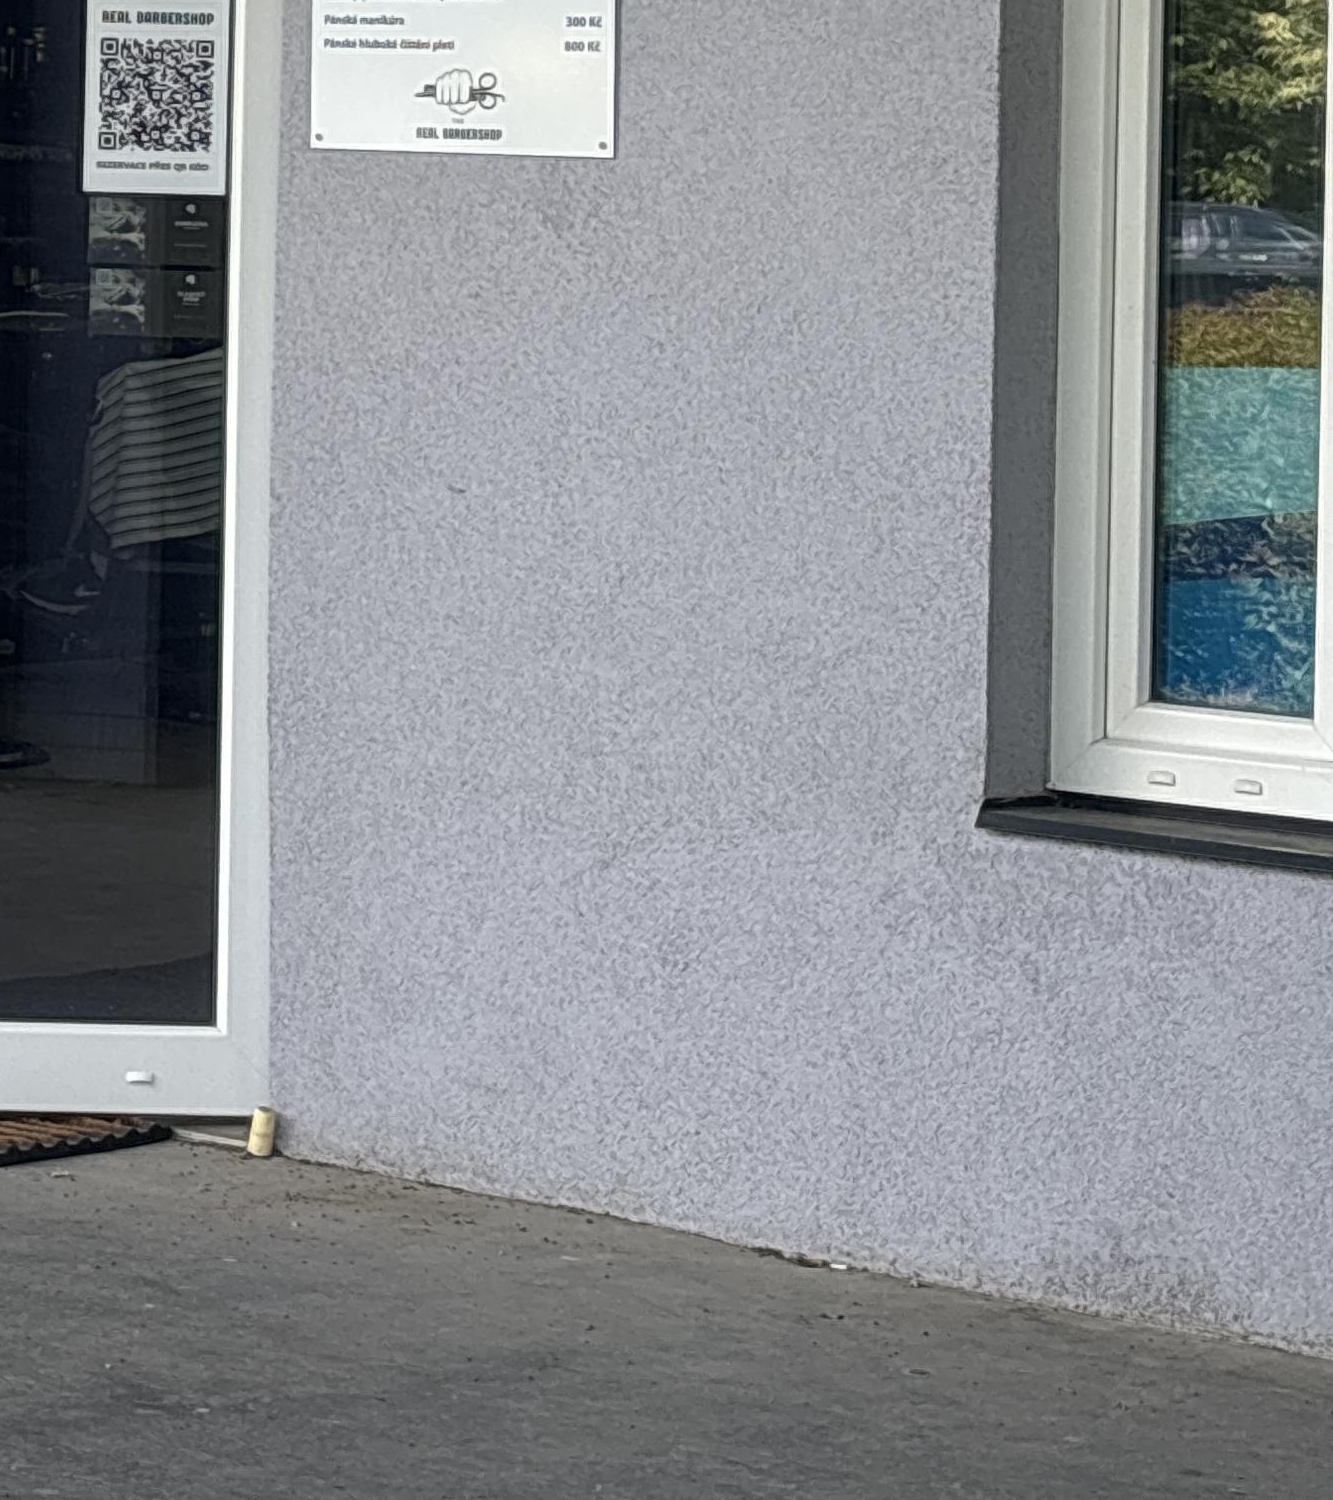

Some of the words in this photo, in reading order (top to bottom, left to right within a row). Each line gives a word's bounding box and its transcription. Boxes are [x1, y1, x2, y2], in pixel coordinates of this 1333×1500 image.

[102, 10, 131, 23] REAL
[137, 11, 214, 25] BARBERSHOP
[565, 16, 586, 28] 300
[588, 16, 602, 28] Kč
